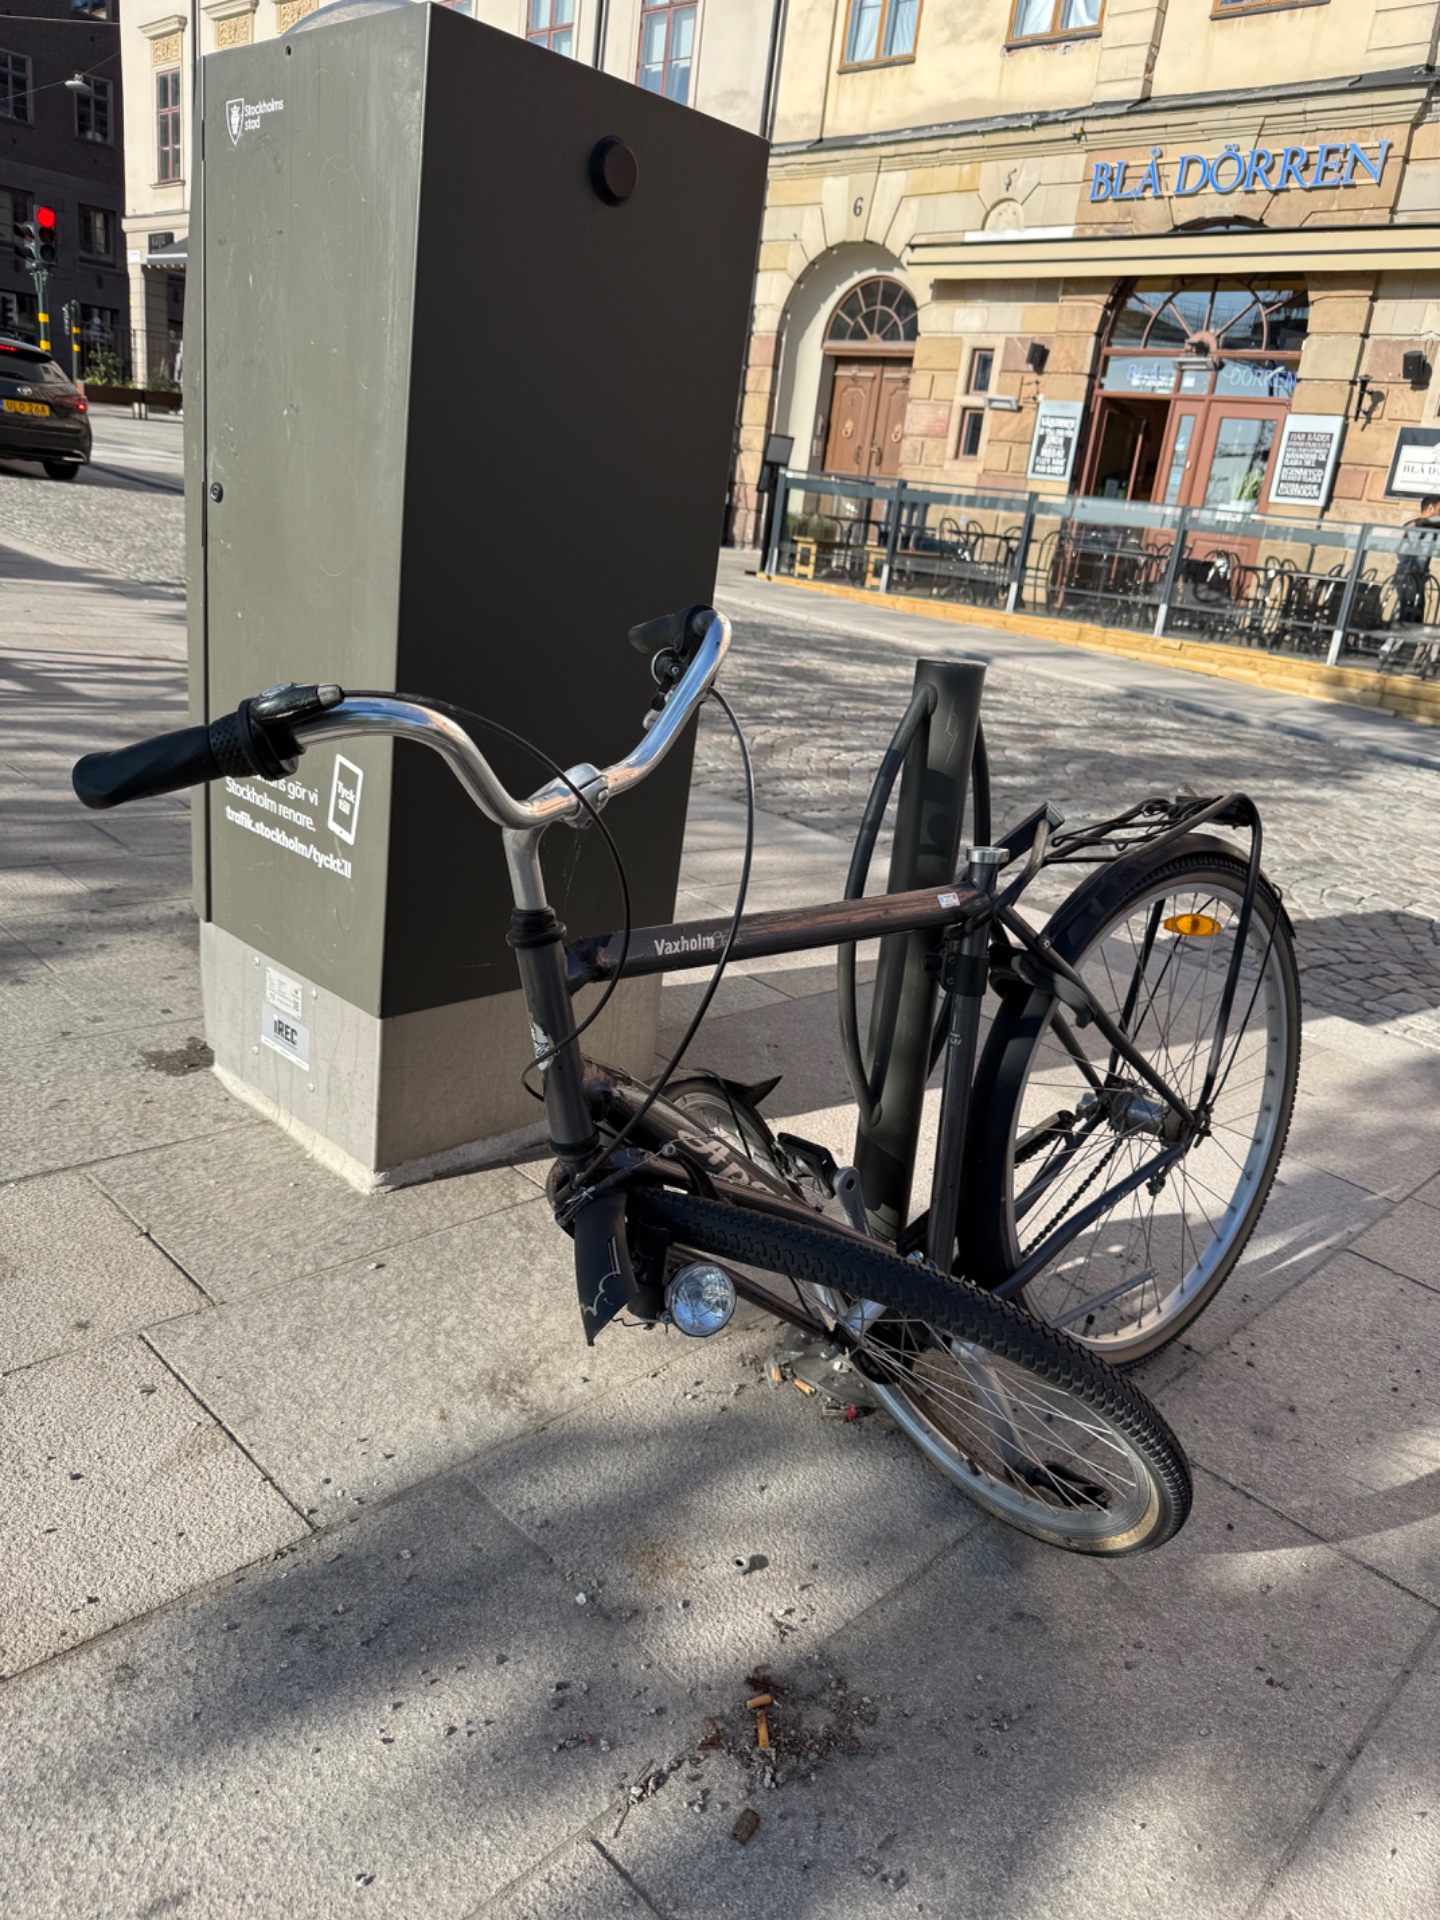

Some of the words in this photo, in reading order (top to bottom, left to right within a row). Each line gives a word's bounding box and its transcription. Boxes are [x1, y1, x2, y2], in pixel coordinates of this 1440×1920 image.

[244, 98, 284, 117] Stockholms
[244, 115, 261, 130] stad
[1088, 146, 1163, 201] BLÅ
[1173, 139, 1392, 195] DÖRREN
[852, 196, 864, 217] 6
[287, 780, 307, 801] gör
[307, 788, 318, 806] vi
[337, 780, 356, 804] Tyck
[225, 776, 277, 814] Stockholm
[278, 803, 316, 832] renare.
[338, 798, 350, 816] till
[654, 933, 716, 956] Vaxholm
